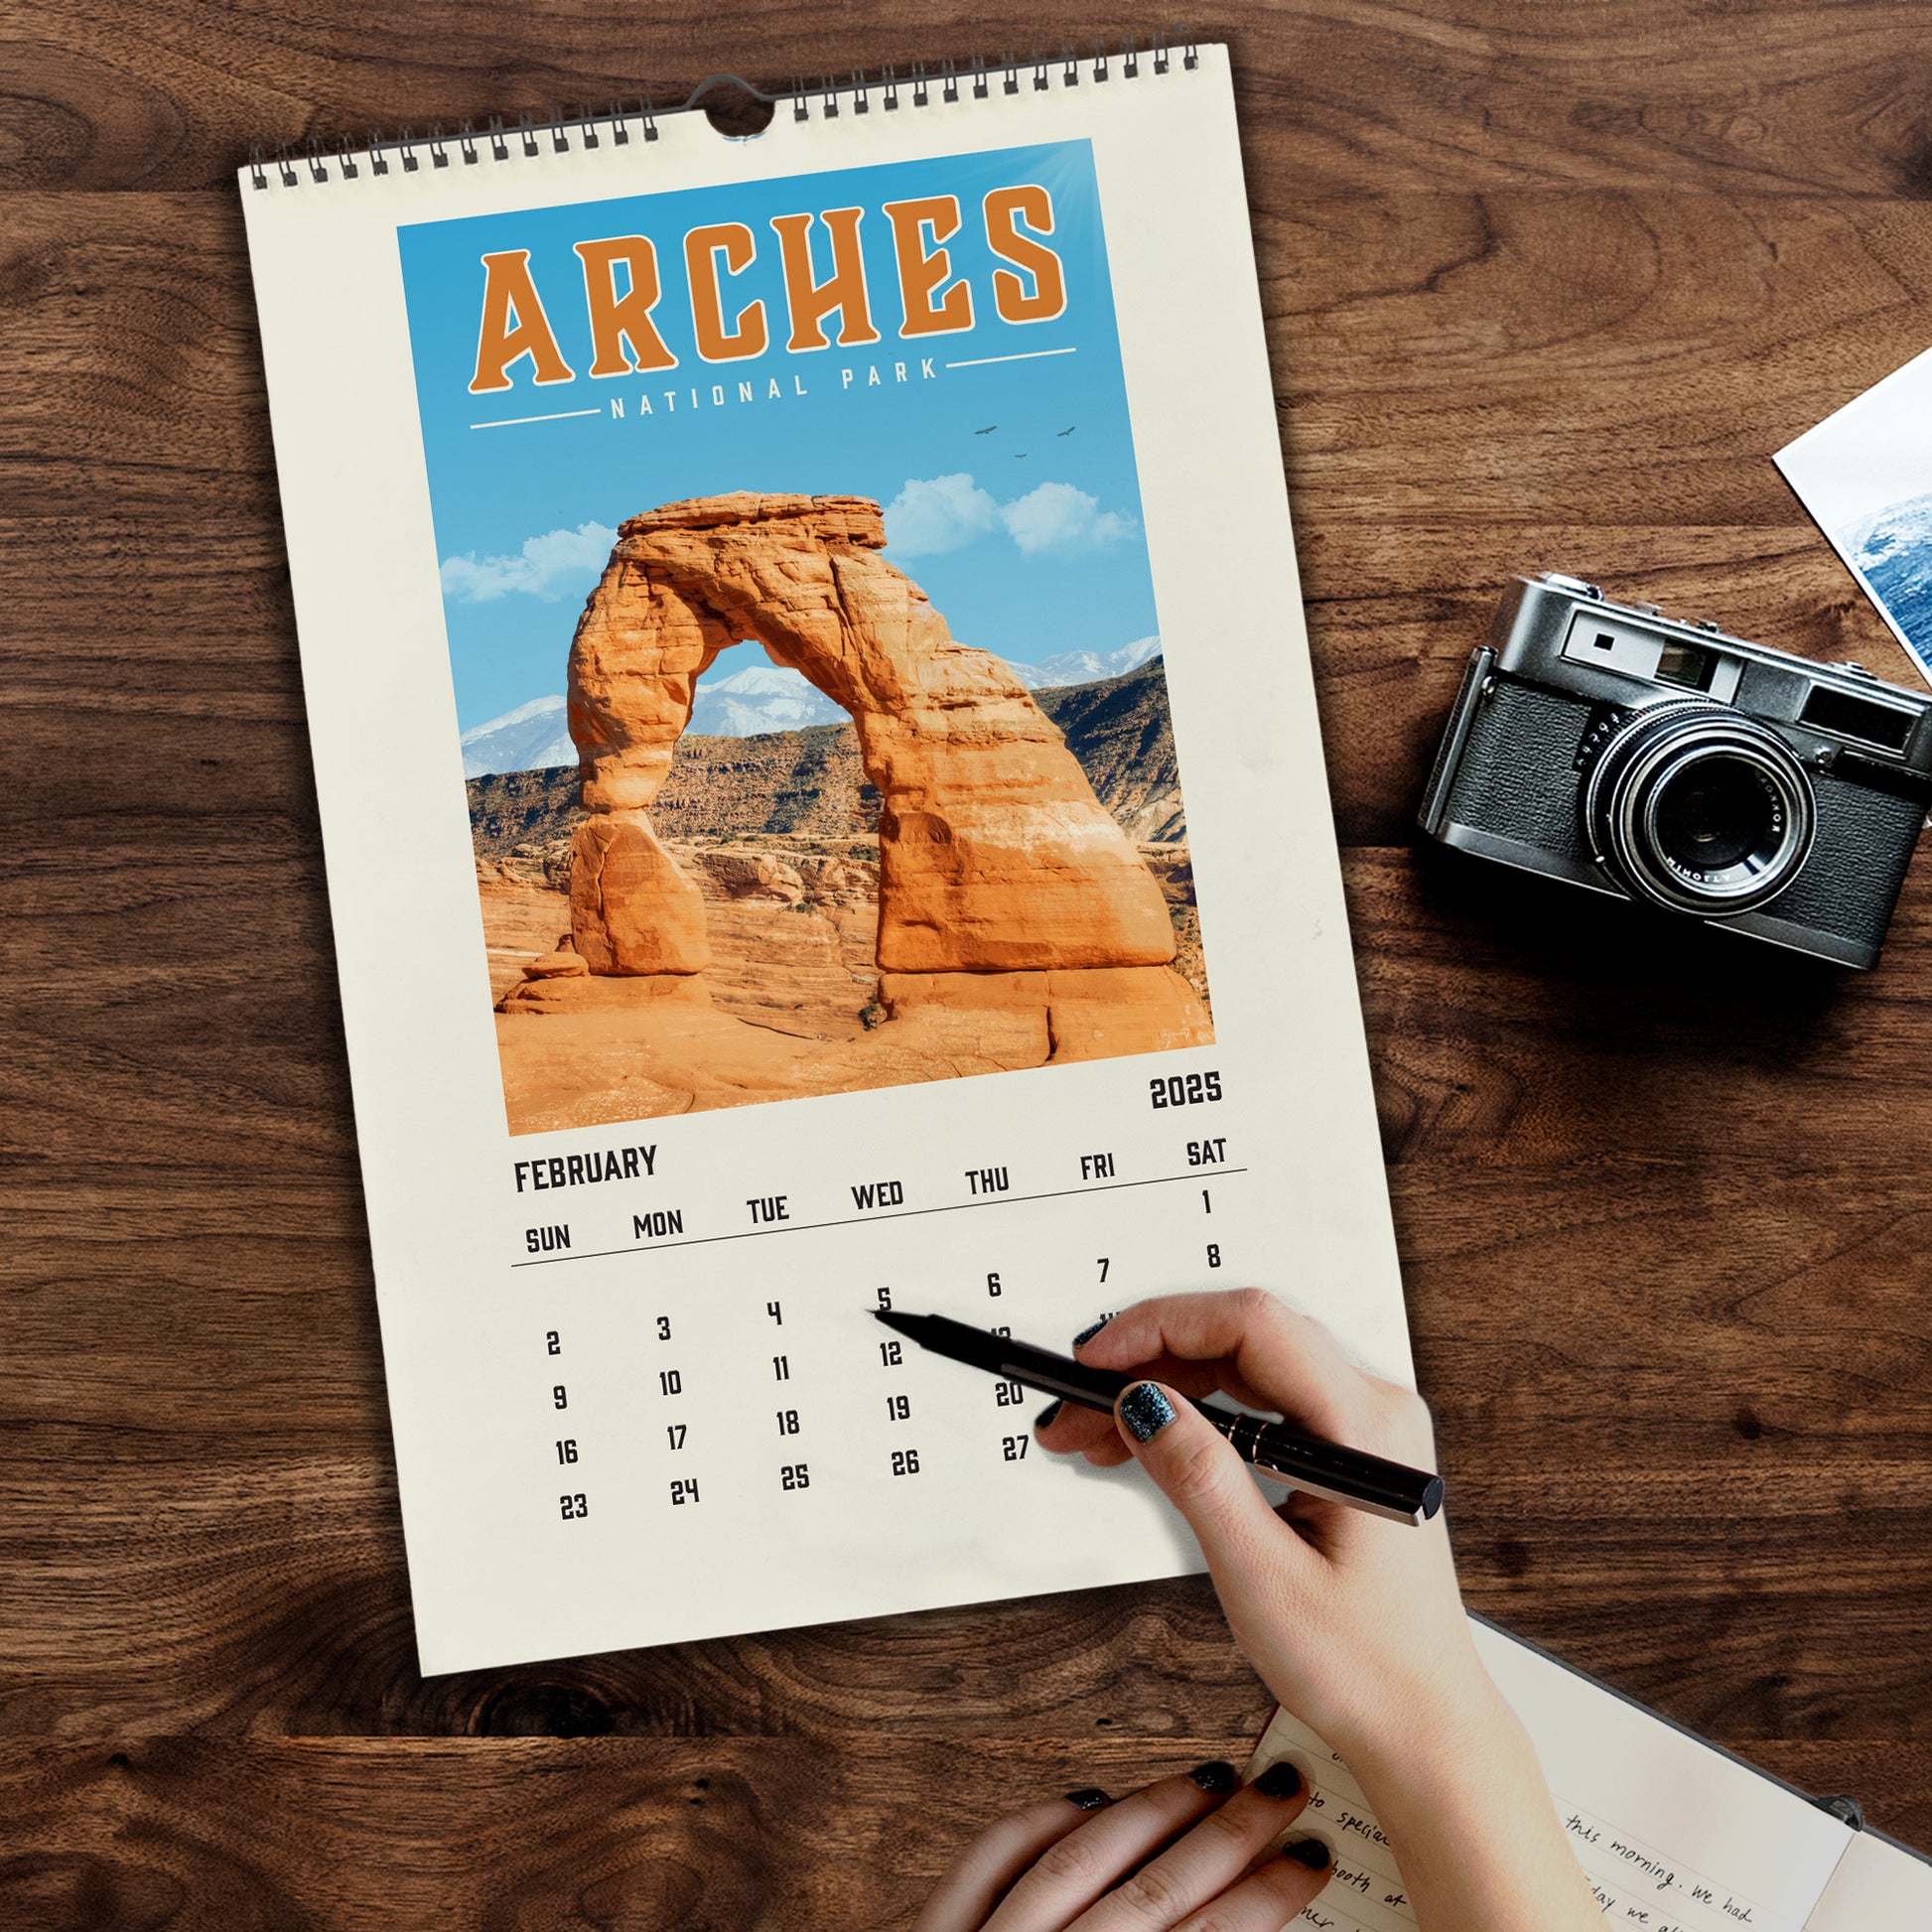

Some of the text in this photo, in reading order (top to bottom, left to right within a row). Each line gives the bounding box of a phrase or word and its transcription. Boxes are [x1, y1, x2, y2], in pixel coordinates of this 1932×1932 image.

[467, 183, 1068, 395] ARCHES
[611, 357, 936, 420] NATIONAL PARK
[513, 1070, 1223, 1193] FEBRUARY 2025
[525, 1138, 1227, 1254] SUN MON TUE WED THU FRI SAT
[1201, 1189, 1211, 1214] 1
[546, 1243, 1222, 1356] 2 3 4 5 6 7 8
[553, 1340, 903, 1410] 9 10 11 12
[555, 1381, 1024, 1465] 16 17 18 19 20
[559, 1434, 1030, 1521] 23 24 25 26 27
[1384, 1893, 1407, 1907] at
[1566, 1814, 1600, 1844] this
[1723, 1897, 1752, 1923] had
